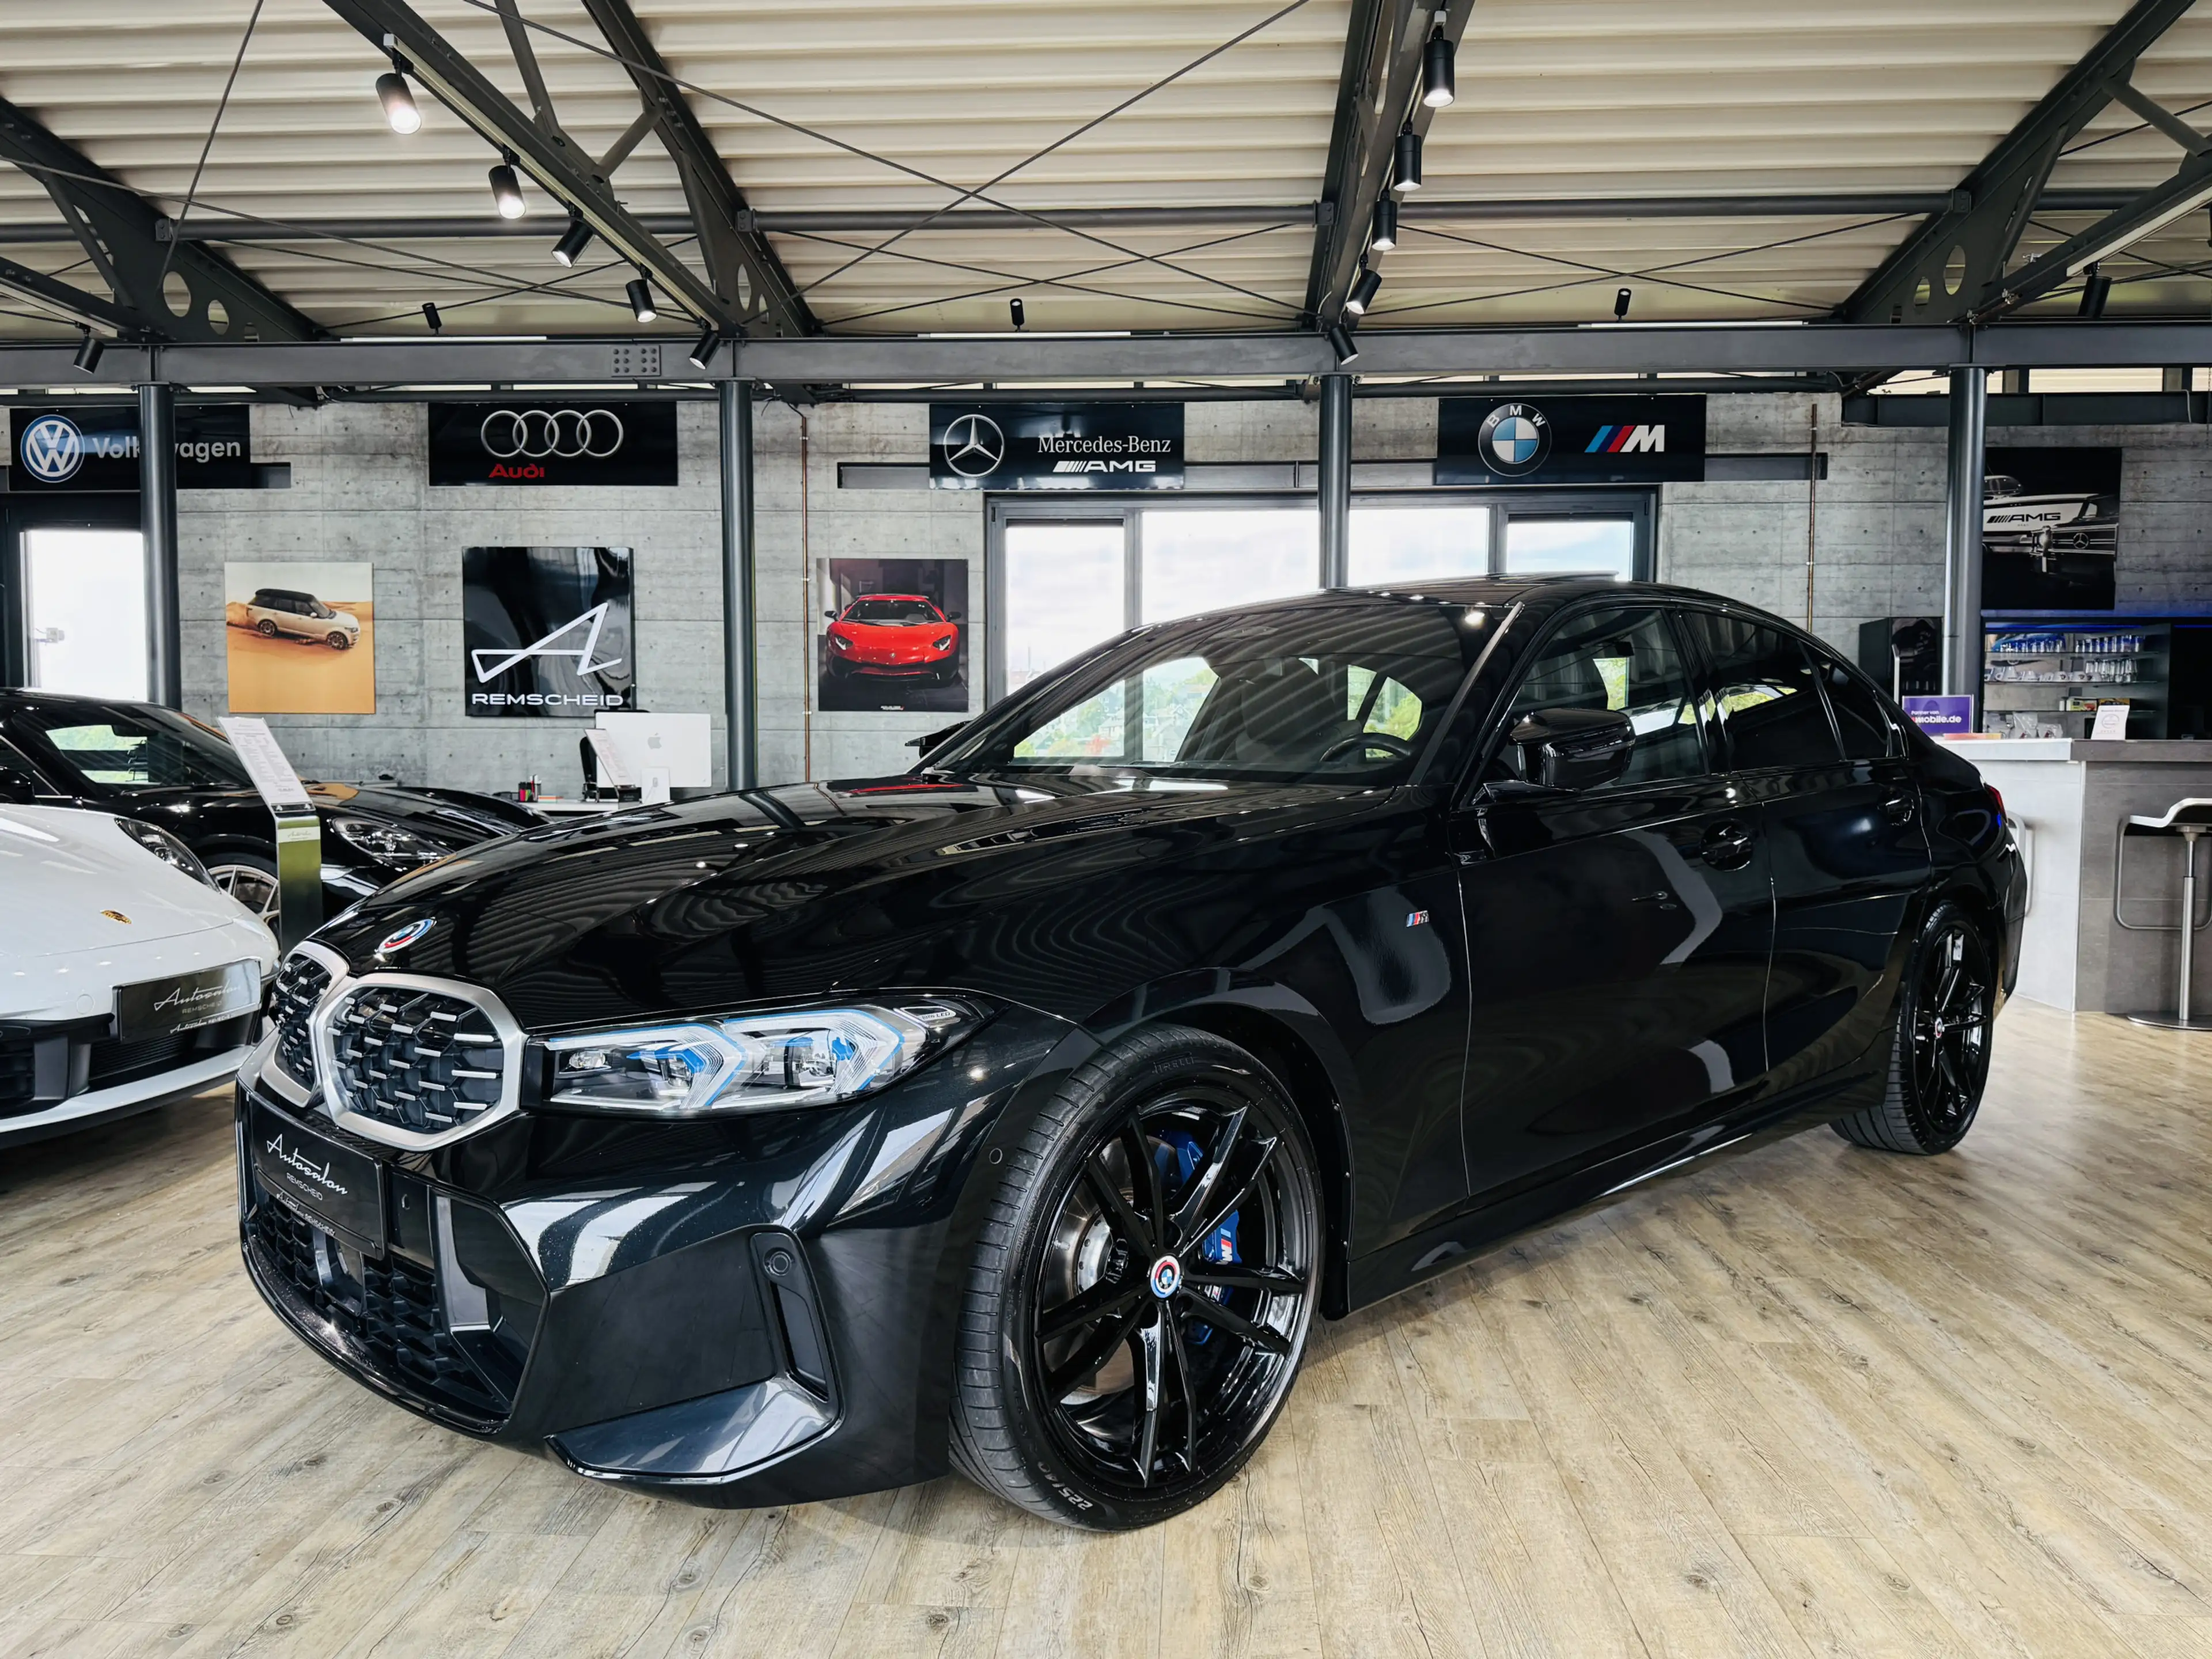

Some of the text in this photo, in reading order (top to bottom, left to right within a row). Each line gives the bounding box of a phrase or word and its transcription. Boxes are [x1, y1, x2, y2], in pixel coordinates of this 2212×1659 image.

[1486, 404, 1545, 428] BMW
[92, 436, 241, 463] Volkagen
[1037, 435, 1171, 453] Mercedes-Benz
[488, 464, 545, 478] Audi
[1083, 460, 1156, 472] AMG
[472, 693, 624, 706] REMSCHEID
[266, 1133, 348, 1195] Autosalon
[286, 1172, 323, 1201] REMSCHEID
